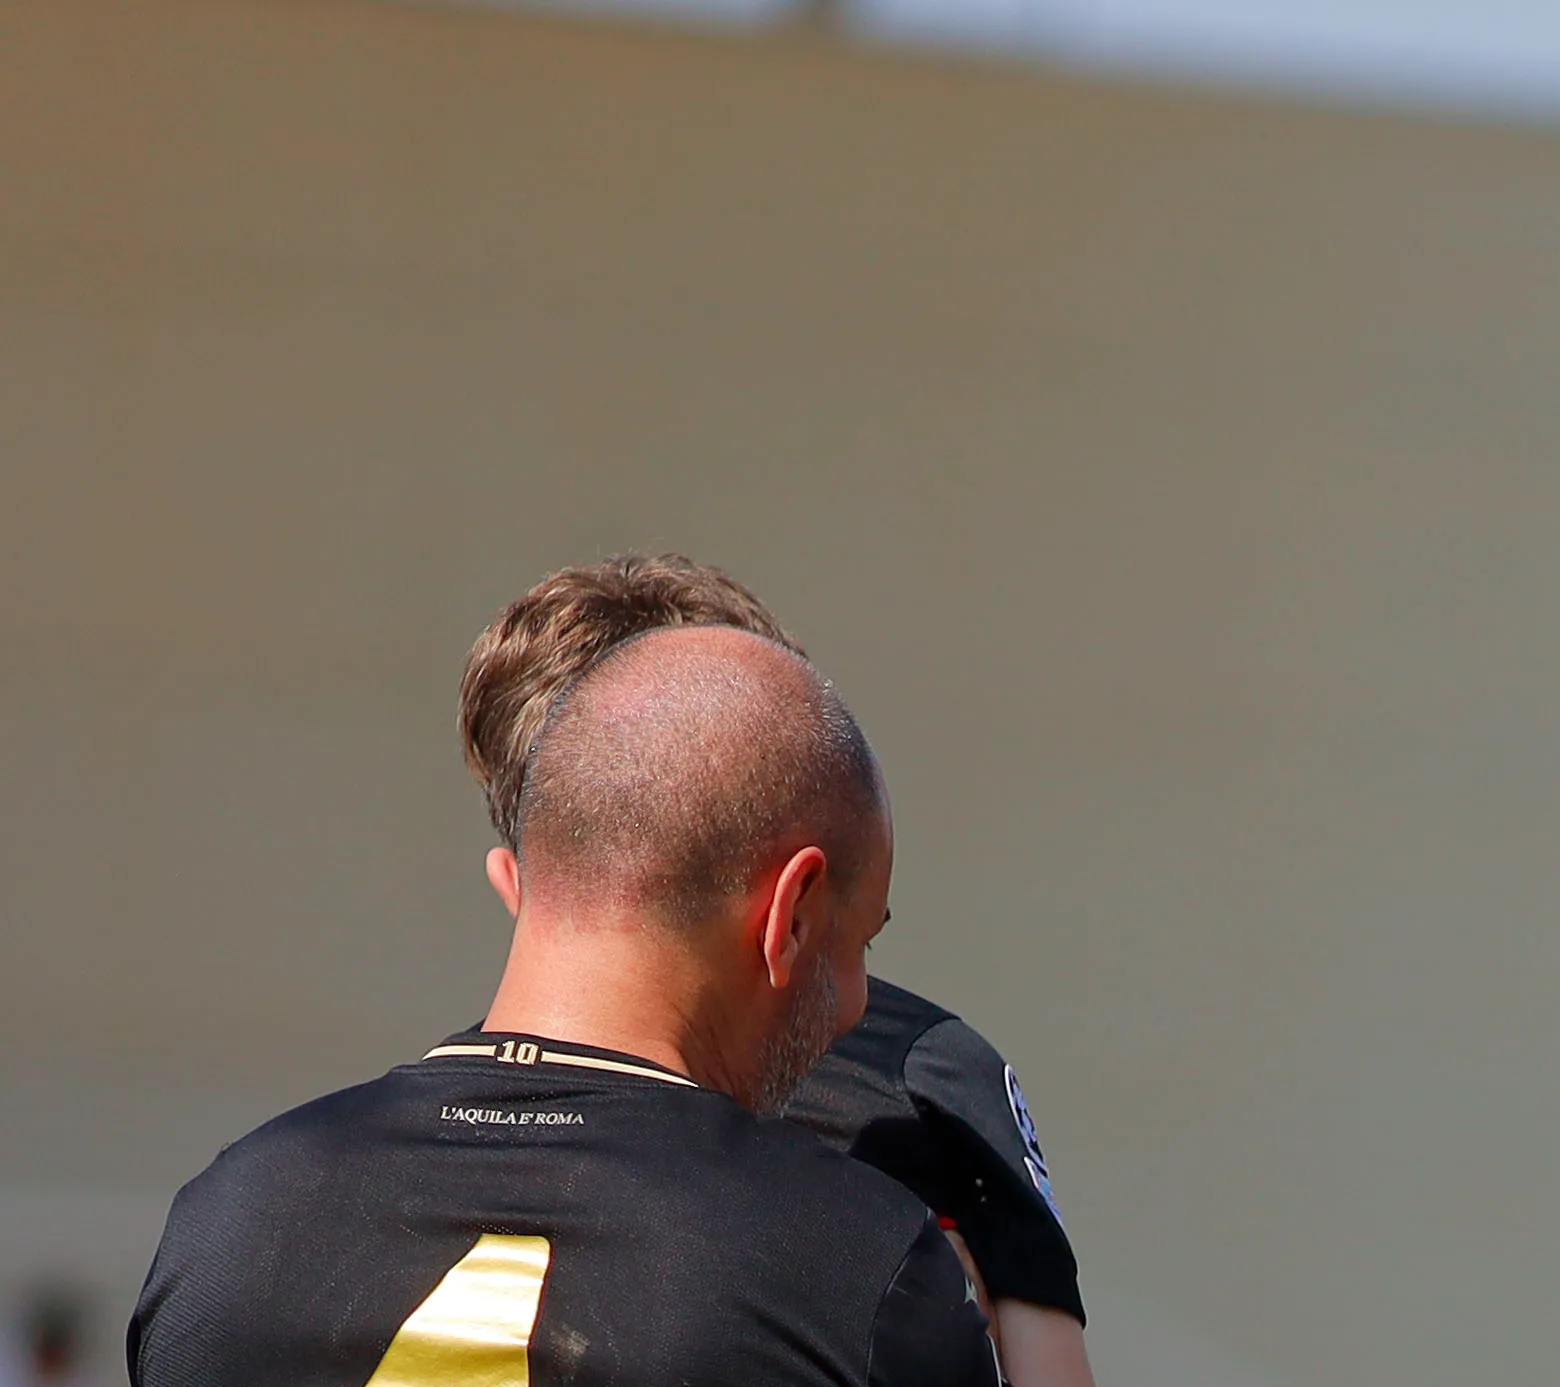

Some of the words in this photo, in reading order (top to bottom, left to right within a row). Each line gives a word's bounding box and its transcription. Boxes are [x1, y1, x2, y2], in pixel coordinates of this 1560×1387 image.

[497, 1040, 539, 1066] 10
[440, 1106, 516, 1125] L'AQUILA
[535, 1112, 585, 1125] ROMA
